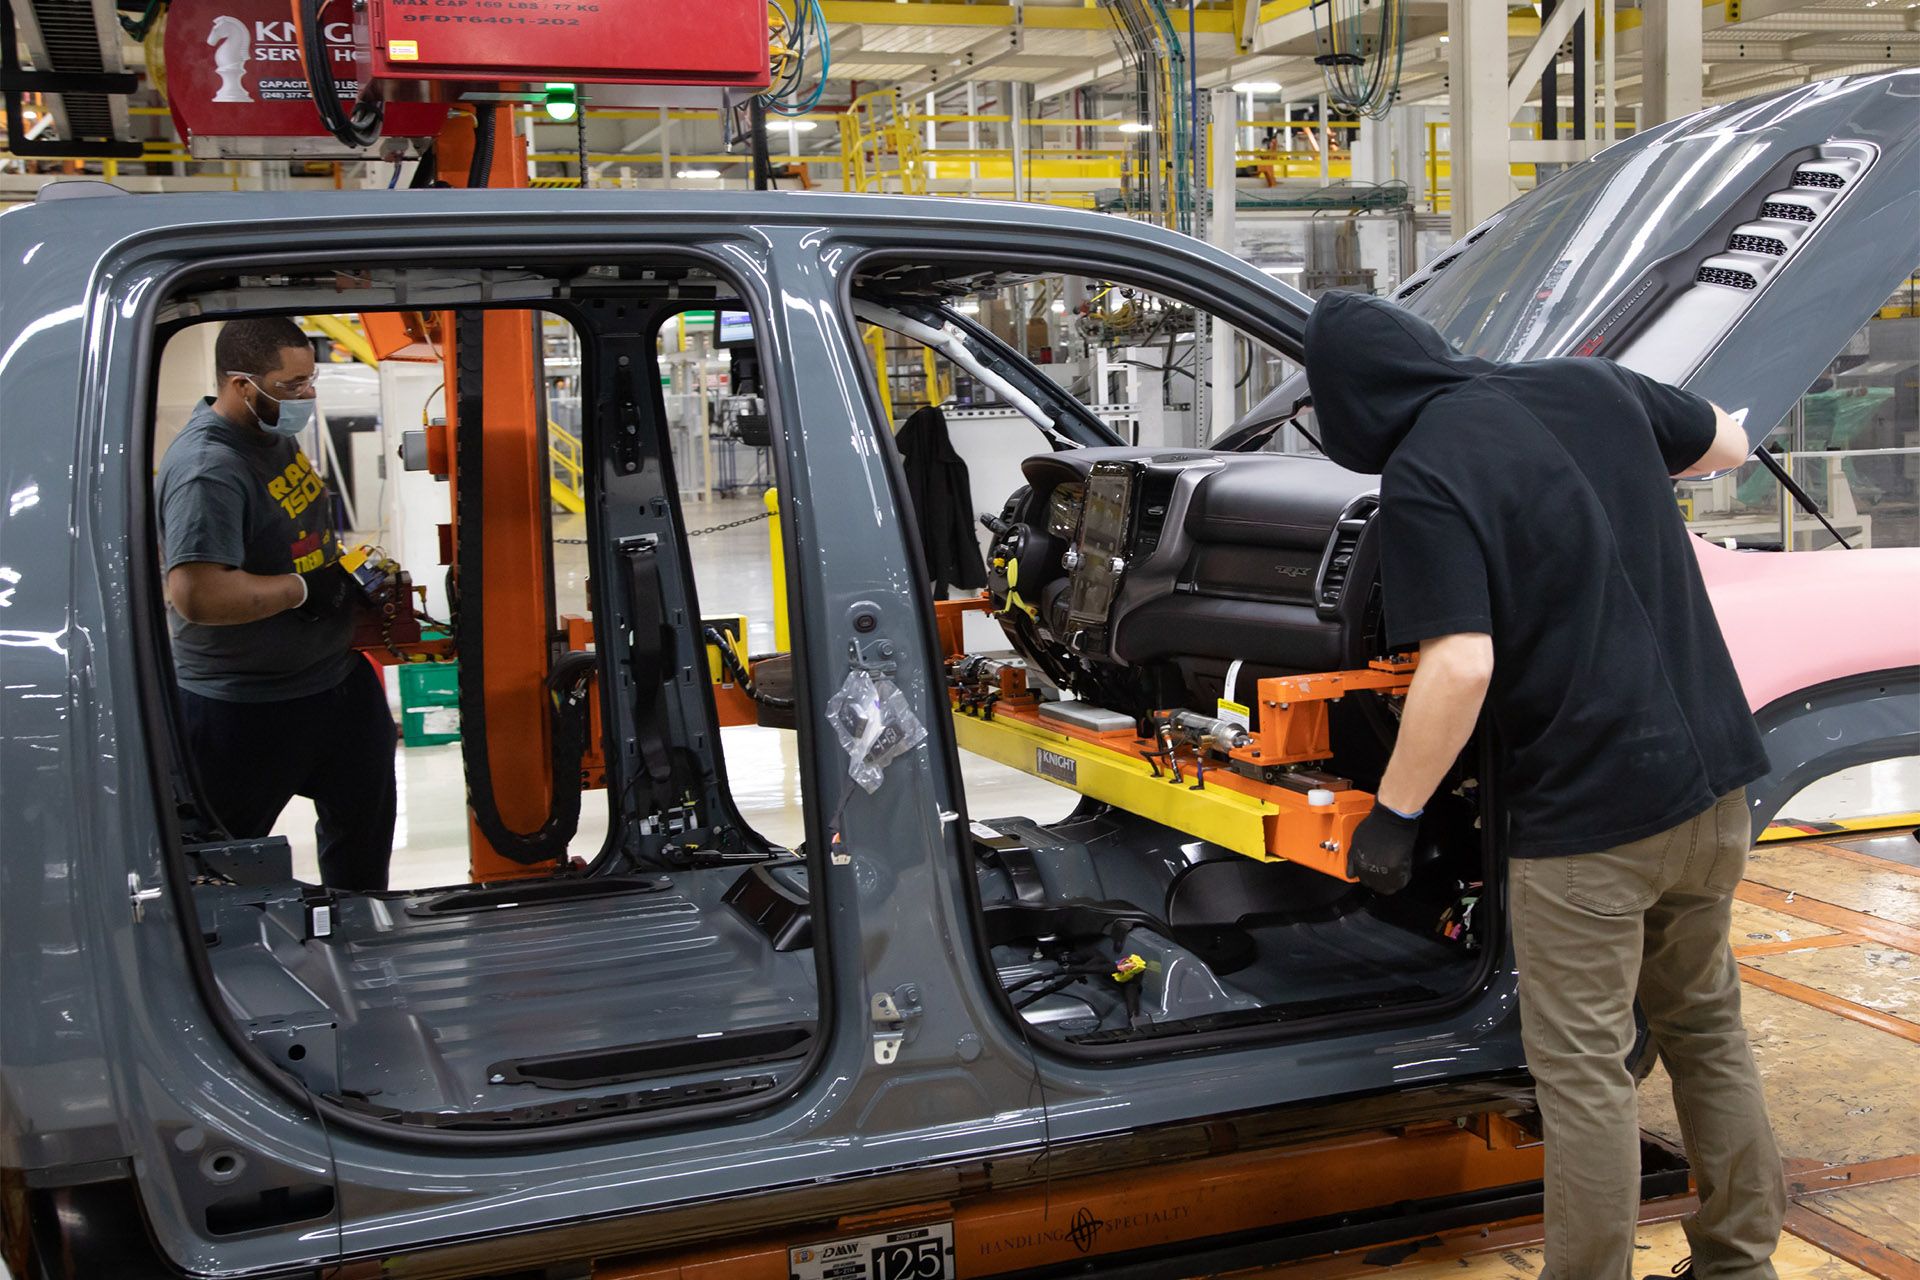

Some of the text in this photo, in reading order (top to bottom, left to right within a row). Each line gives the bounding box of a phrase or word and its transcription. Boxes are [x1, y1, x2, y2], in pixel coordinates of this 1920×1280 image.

[508, 2, 538, 10] LBS
[577, 4, 599, 12] KG
[403, 14, 579, 26] 9FDT6401-202
[255, 21, 353, 43] KNG
[255, 48, 301, 61] SER
[259, 80, 308, 89] CAPACIT
[1043, 750, 1076, 772] KNIGHT
[980, 1205, 1192, 1255] HANDLING SPECIALTY
[822, 1242, 861, 1259] DMW
[876, 1242, 941, 1280] 125
